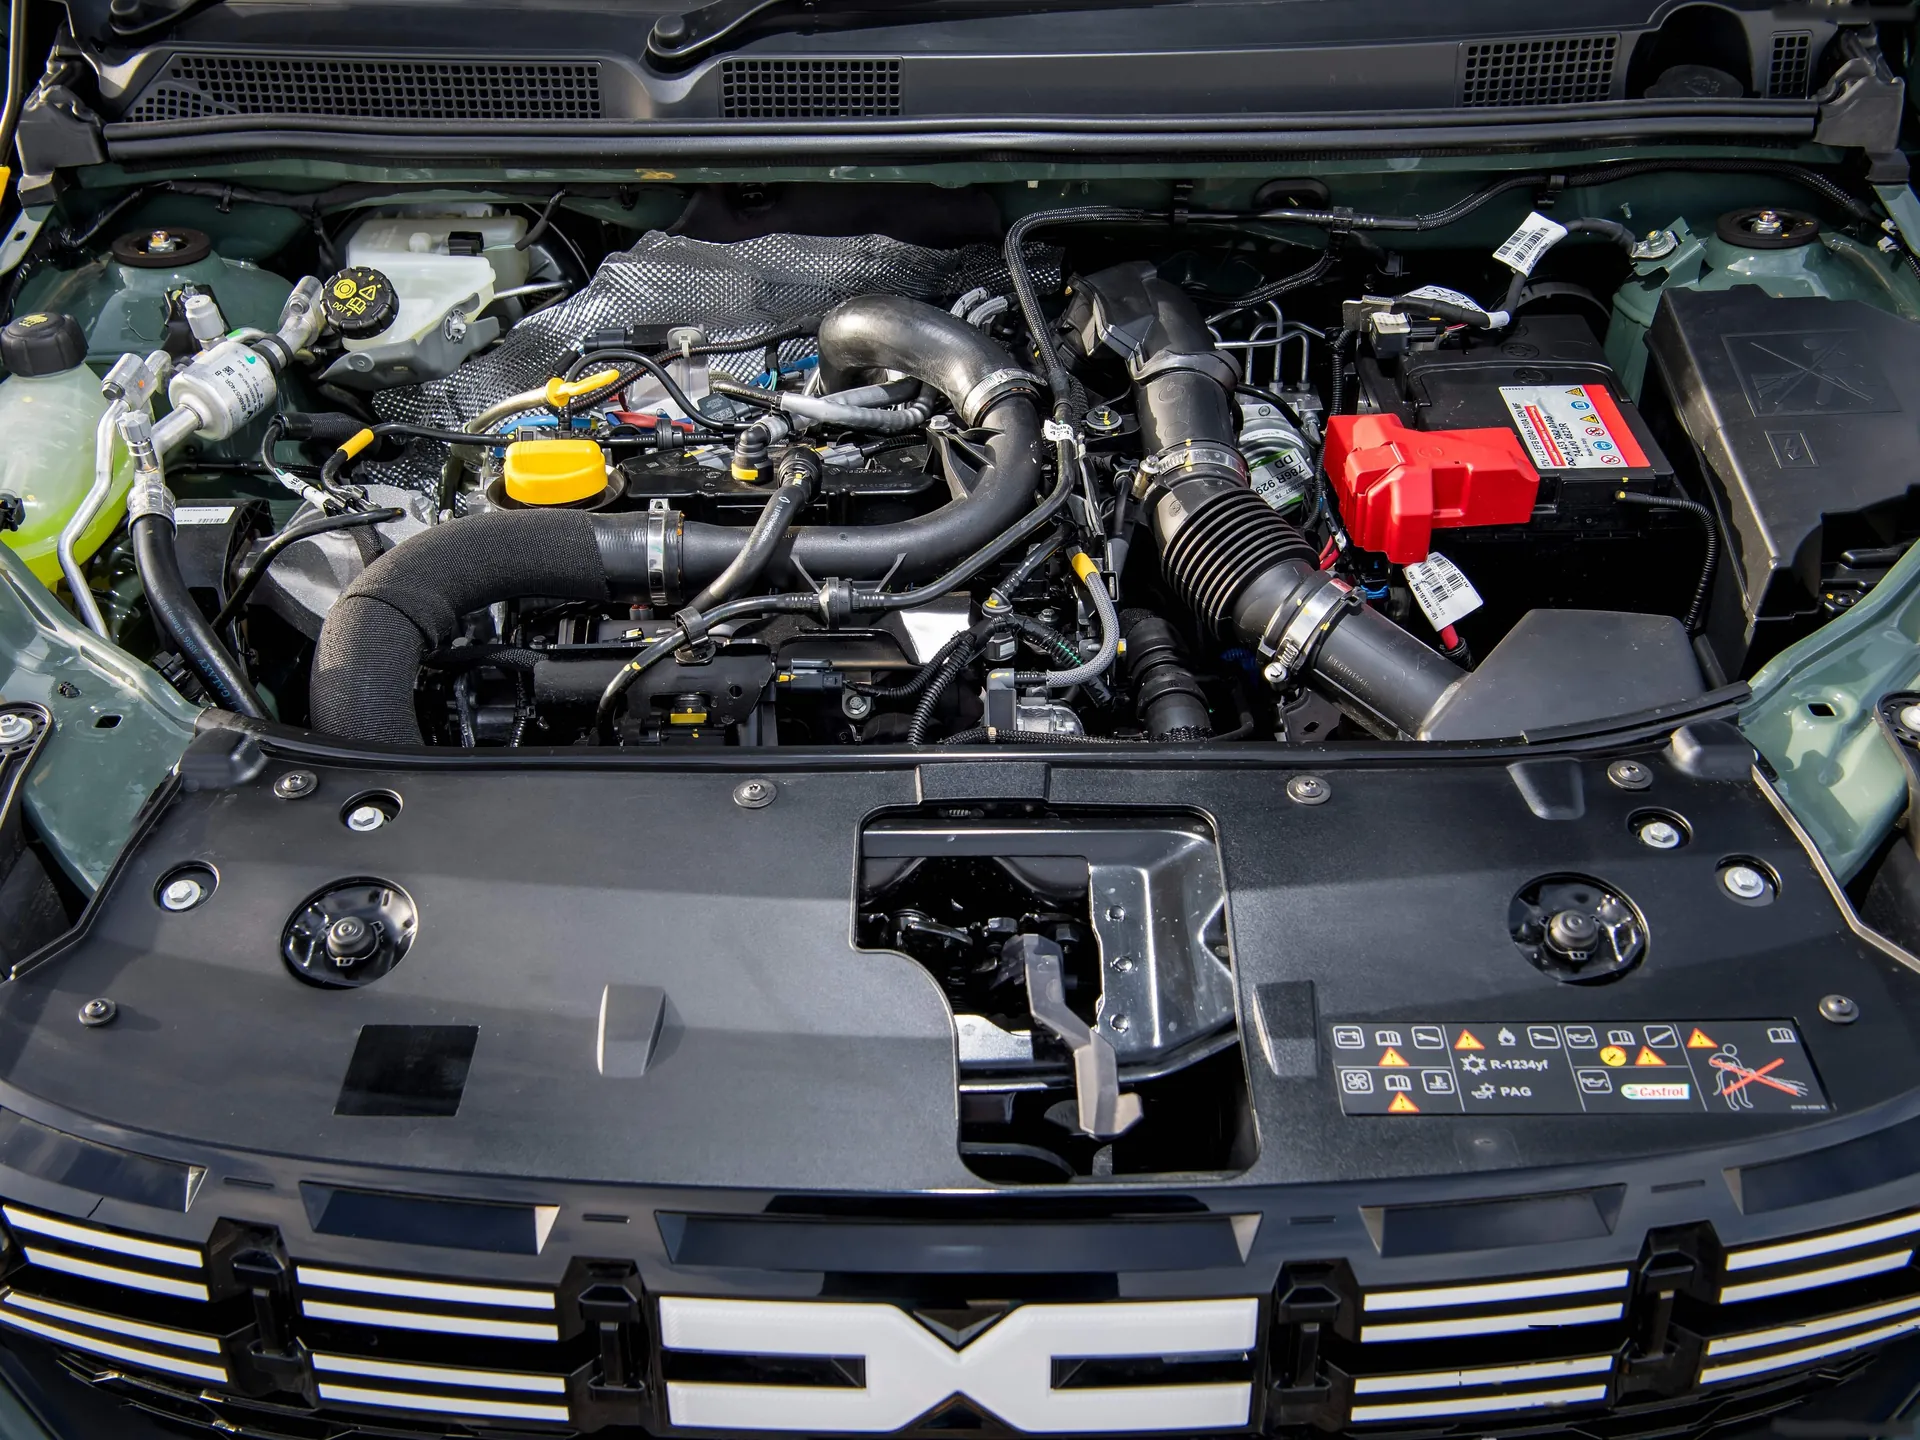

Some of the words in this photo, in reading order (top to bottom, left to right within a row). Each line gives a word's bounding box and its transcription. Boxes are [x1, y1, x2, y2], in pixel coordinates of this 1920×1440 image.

[332, 302, 347, 312] DOT
[1274, 454, 1293, 468] DD
[1278, 465, 1305, 484] 786R
[198, 658, 230, 698] GALAXY
[1490, 1059, 1548, 1072] R-1234yf
[1500, 1086, 1532, 1097] PAG
[1640, 1087, 1684, 1096] Castrol
